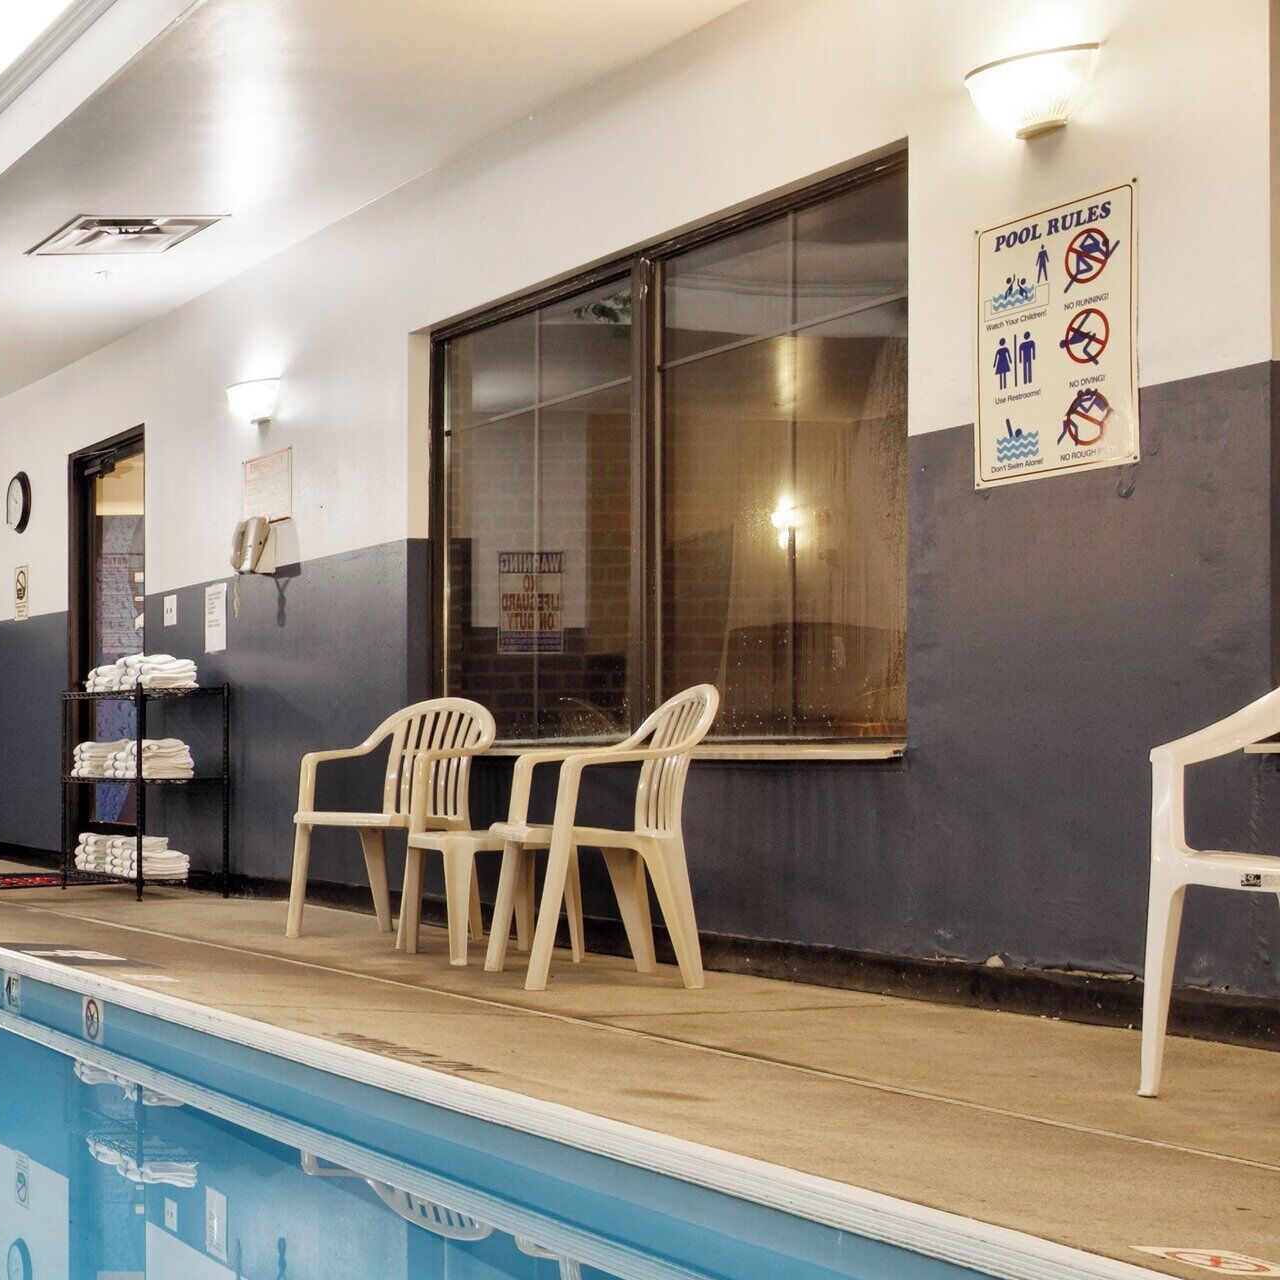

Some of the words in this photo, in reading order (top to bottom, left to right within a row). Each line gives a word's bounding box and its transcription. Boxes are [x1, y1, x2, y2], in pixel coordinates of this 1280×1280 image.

[994, 223, 1041, 252] POOL
[1046, 201, 1112, 236] RULES
[1064, 302, 1074, 310] NO
[1076, 292, 1109, 307] RUNNING!
[986, 322, 1004, 331] Watch
[1005, 318, 1019, 326] Your
[1020, 309, 1047, 322] Children!
[1069, 380, 1079, 388] NO
[1081, 374, 1105, 386] DIVING!
[1008, 388, 1041, 402] Restrooms!
[1060, 453, 1070, 461] NO
[1071, 448, 1096, 459] ROUGH
[991, 465, 1006, 473] Don't
[1008, 462, 1023, 471] Swim
[1024, 457, 1043, 467] Alone!
